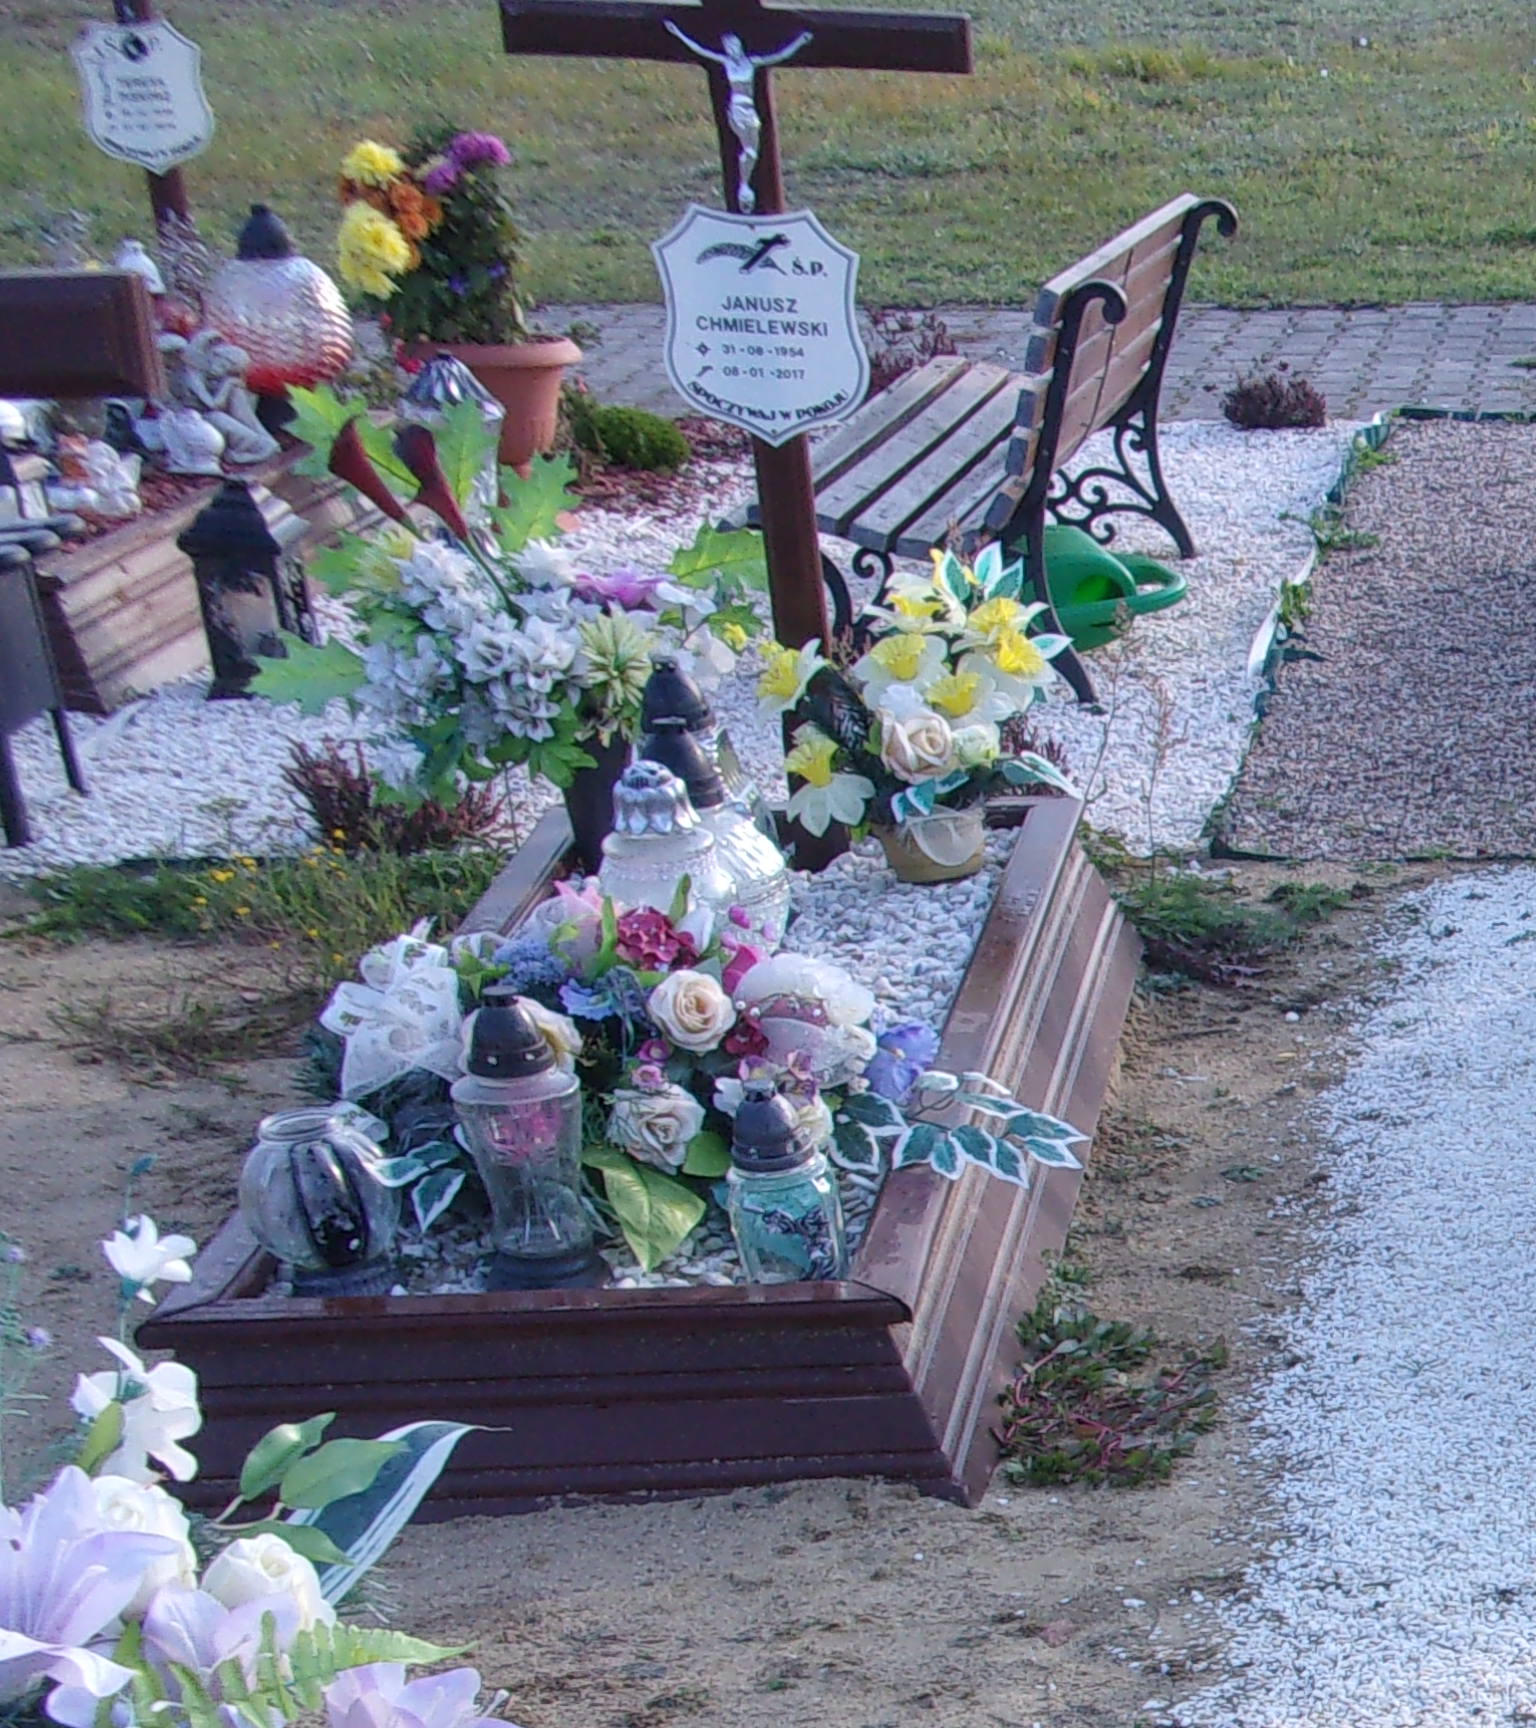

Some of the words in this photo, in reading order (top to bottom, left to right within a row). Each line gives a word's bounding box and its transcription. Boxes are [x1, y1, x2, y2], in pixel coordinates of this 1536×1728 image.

[721, 295, 798, 314] JANUSZ
[695, 316, 829, 337] CHMIELEWSKI
[687, 380, 777, 421] SPOCZYWAJ
[779, 410, 792, 421] W
